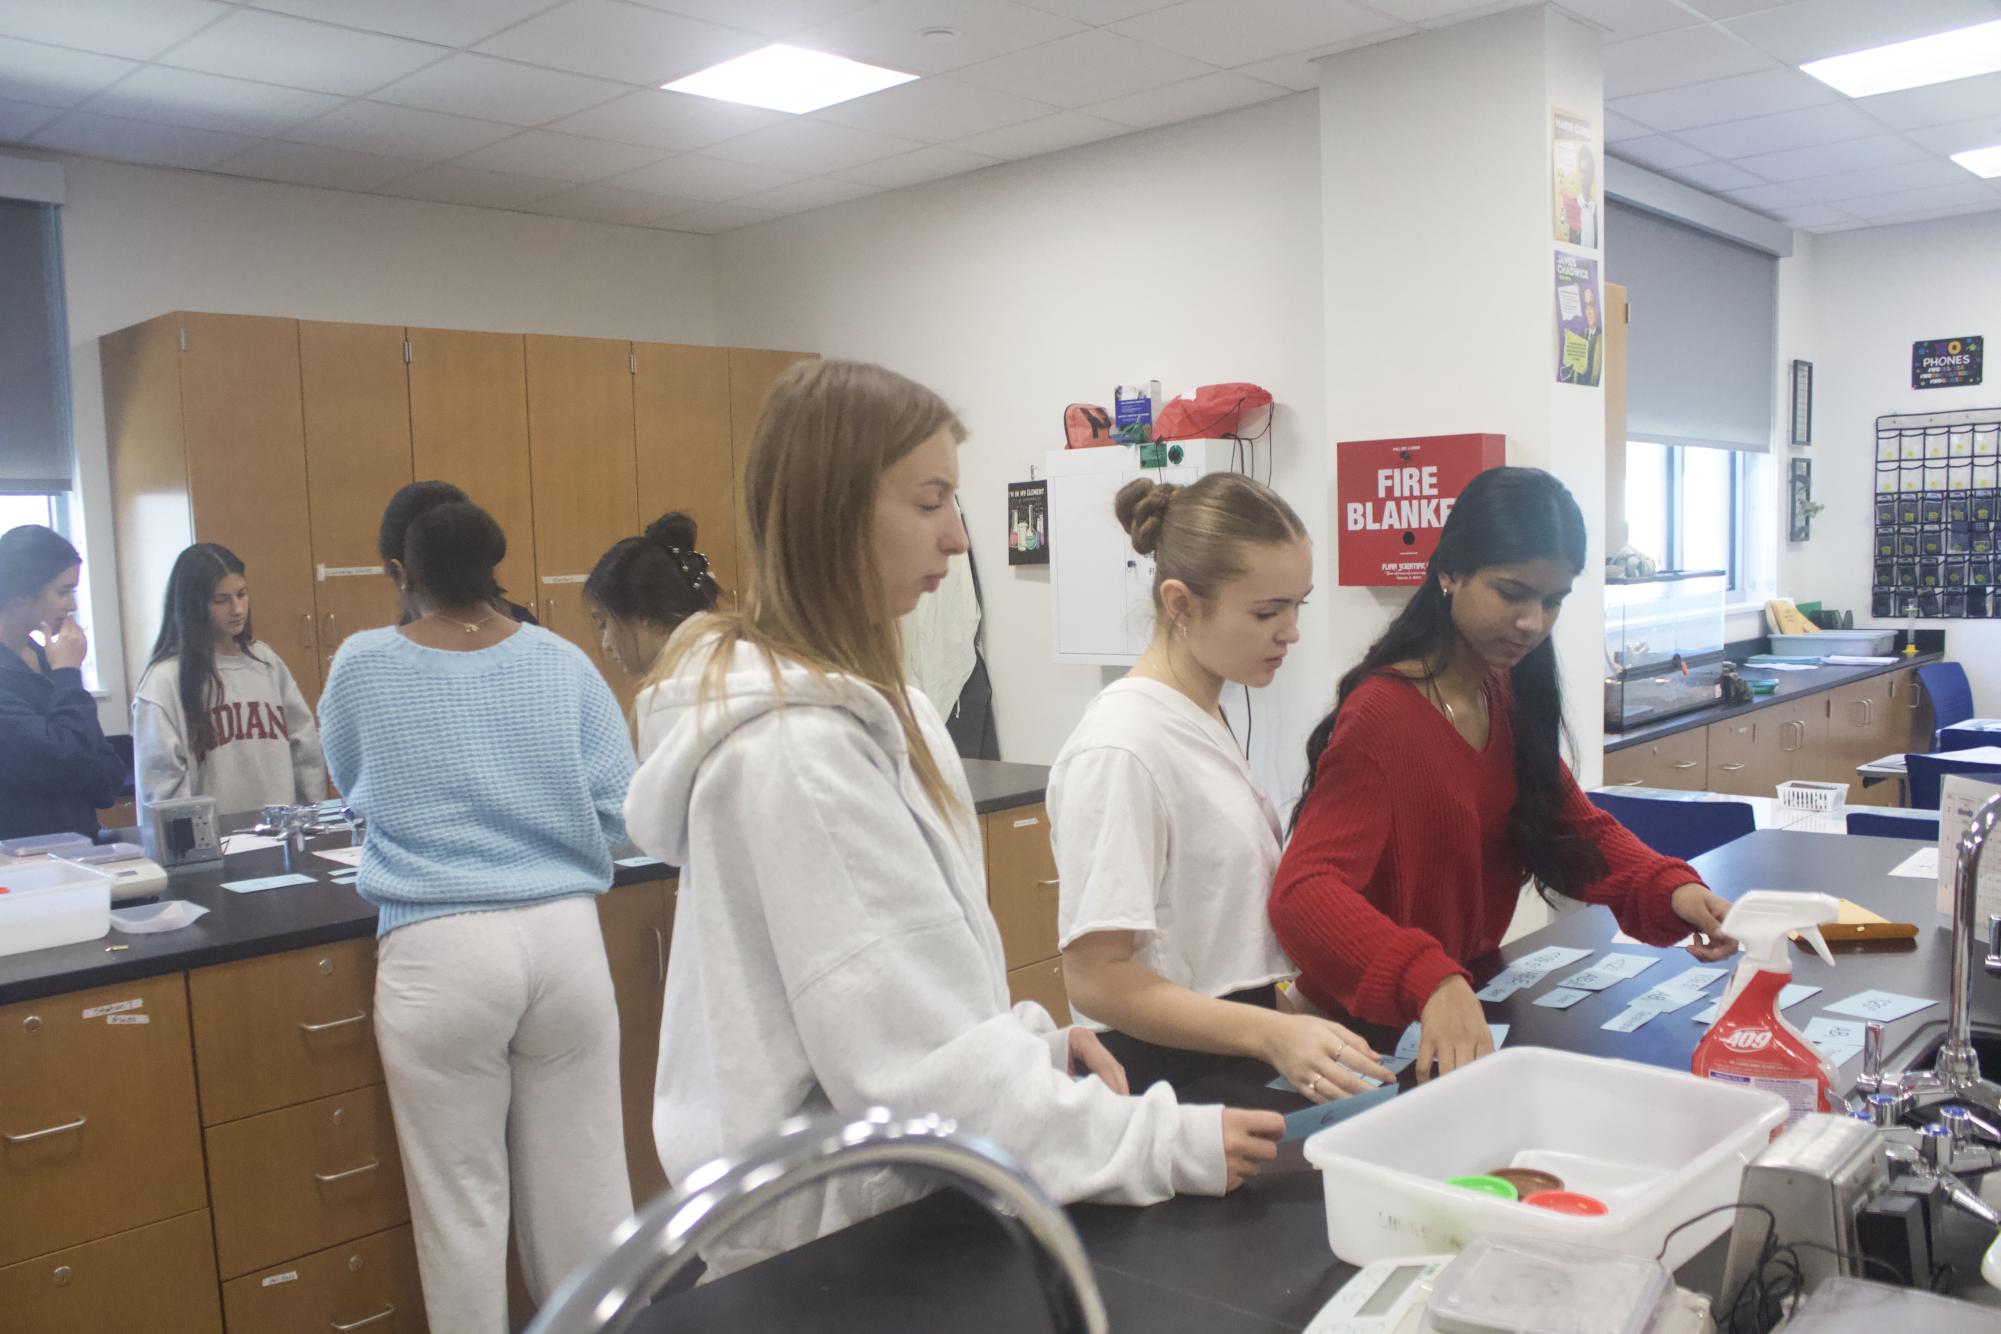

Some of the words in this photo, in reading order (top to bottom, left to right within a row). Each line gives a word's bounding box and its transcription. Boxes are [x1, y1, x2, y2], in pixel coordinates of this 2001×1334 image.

[1923, 354, 1970, 368] PHONES
[1377, 466, 1438, 498] FIRE
[1346, 497, 1457, 531] BLANKE
[1727, 1030, 1773, 1049] 409
